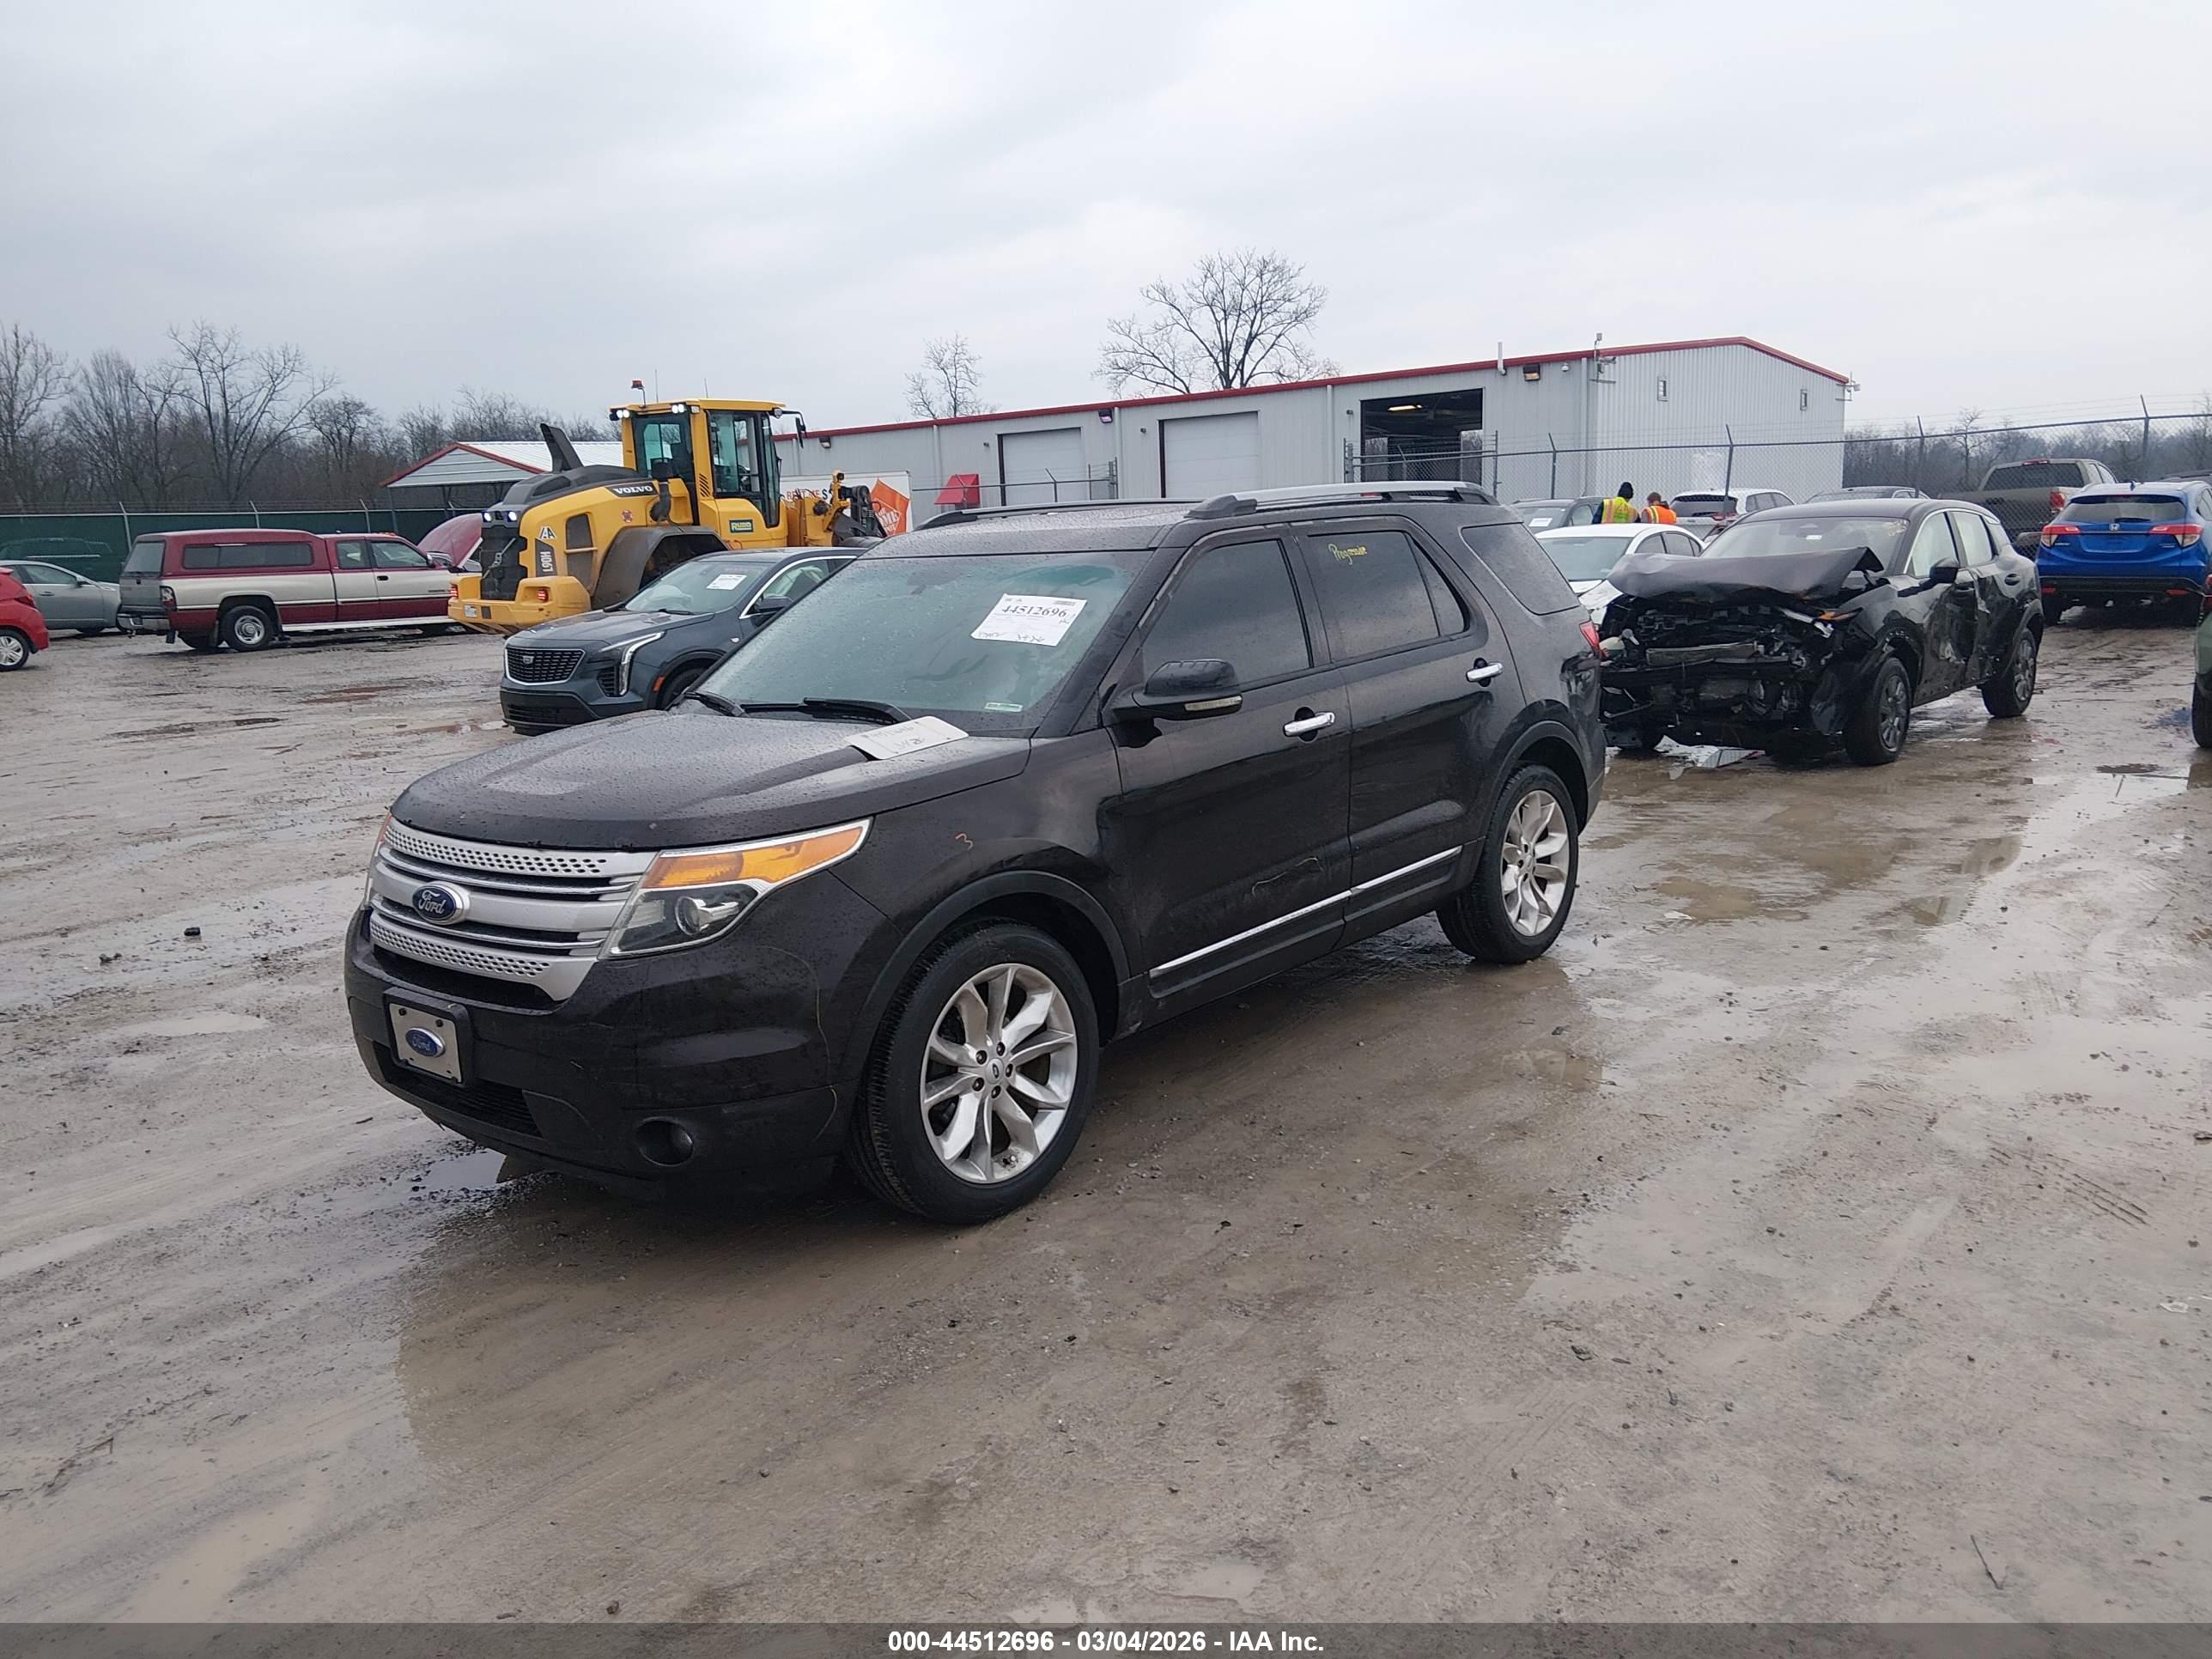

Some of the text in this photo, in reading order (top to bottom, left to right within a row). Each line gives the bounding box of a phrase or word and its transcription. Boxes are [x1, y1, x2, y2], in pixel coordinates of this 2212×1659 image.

[612, 484, 654, 495] VOLVO
[539, 550, 555, 573] L90H
[1001, 605, 1067, 617] 44512696
[418, 890, 447, 915] Ford
